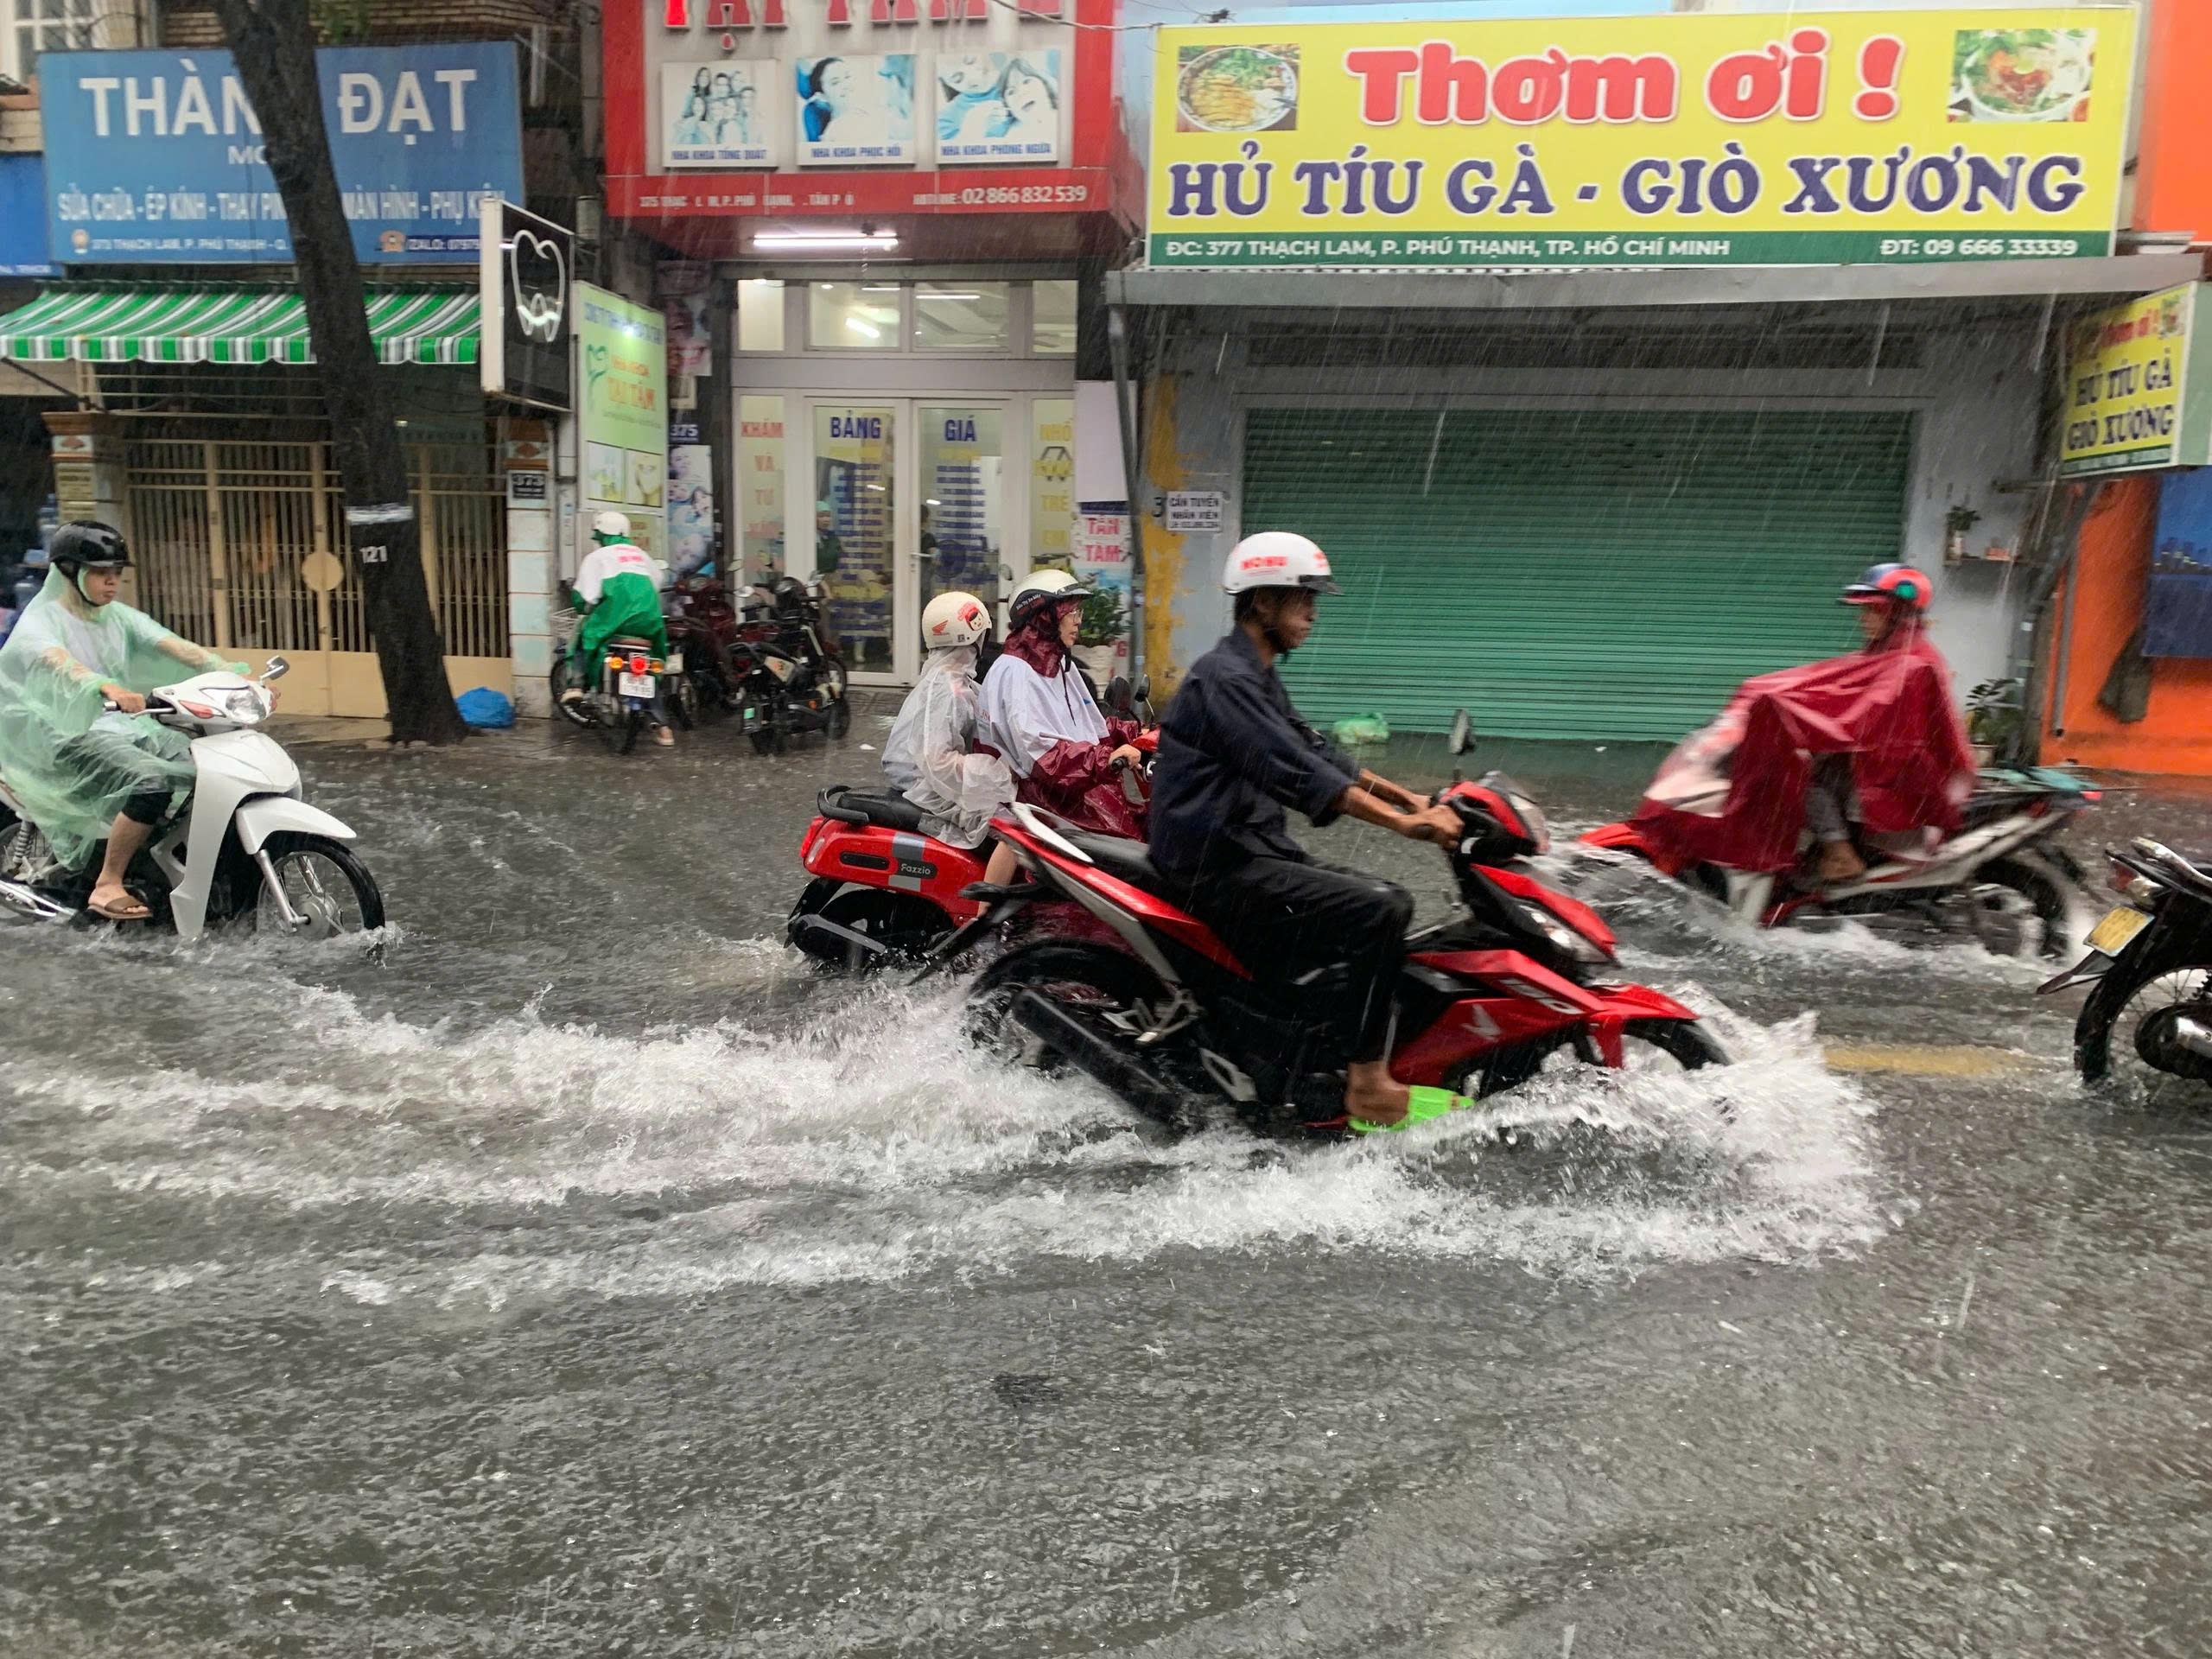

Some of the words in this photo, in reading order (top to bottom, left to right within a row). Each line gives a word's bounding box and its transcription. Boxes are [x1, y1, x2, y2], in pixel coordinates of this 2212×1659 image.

[1345, 41, 1677, 124] Thơm
[1708, 29, 1827, 119] ơi
[1855, 37, 1901, 118] !
[79, 58, 263, 136] THÀN
[337, 69, 477, 145] ĐẠT
[1168, 140, 1273, 216] HỦ
[1294, 144, 1425, 214] TÍU
[1447, 143, 1554, 214] GÀ
[1623, 142, 1759, 214] GIÒ
[1783, 145, 2085, 213] XƯƠNG
[1166, 240, 1202, 257] ĐC:
[1206, 240, 1242, 257] 377
[1246, 240, 1320, 259] THẠCH
[1325, 239, 1376, 257] LAM,
[1381, 239, 1401, 256] P.
[1406, 236, 1453, 256] PHÚ
[1457, 239, 1541, 259] THẠNH,
[1545, 239, 1580, 256] TP.
[1584, 235, 1619, 256] HỒ
[1623, 236, 1666, 256] CHÍ
[1668, 239, 1731, 256] MINH
[1879, 238, 1921, 256] ĐT:
[1923, 238, 1955, 256] 09
[1958, 238, 2005, 256] 666
[2007, 238, 2079, 256] 33339
[2145, 346, 2173, 391] GÀ
[830, 409, 881, 439] BẢNG
[944, 414, 977, 442] GIÁ
[359, 545, 388, 564] 121
[899, 862, 931, 875] Fazzio
